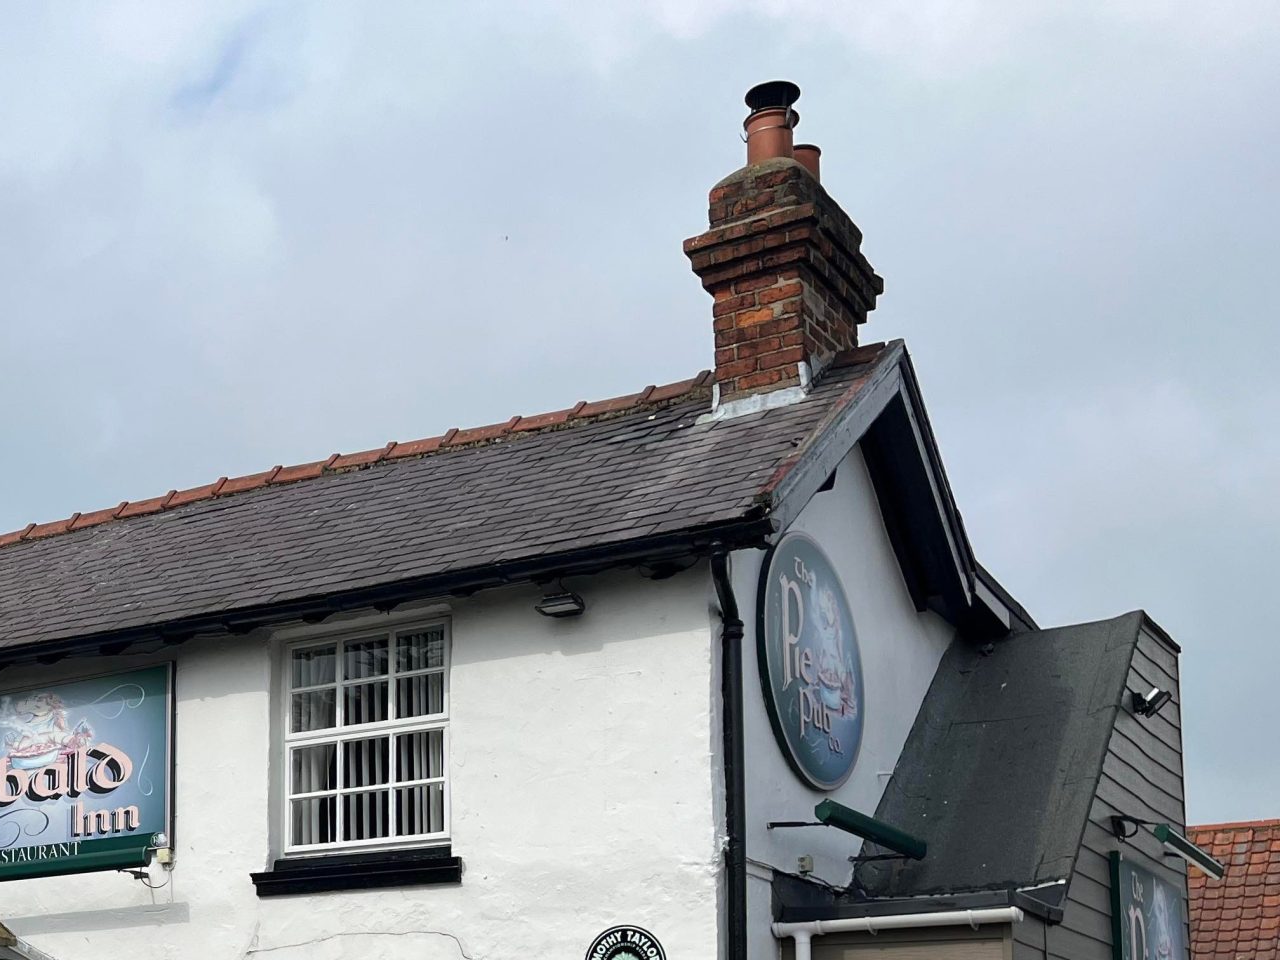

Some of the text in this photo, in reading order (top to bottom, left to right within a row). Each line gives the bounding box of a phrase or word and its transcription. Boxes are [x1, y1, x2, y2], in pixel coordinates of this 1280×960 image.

[794, 556, 815, 588] The
[779, 571, 814, 691] Pie
[71, 802, 140, 837] Inn
